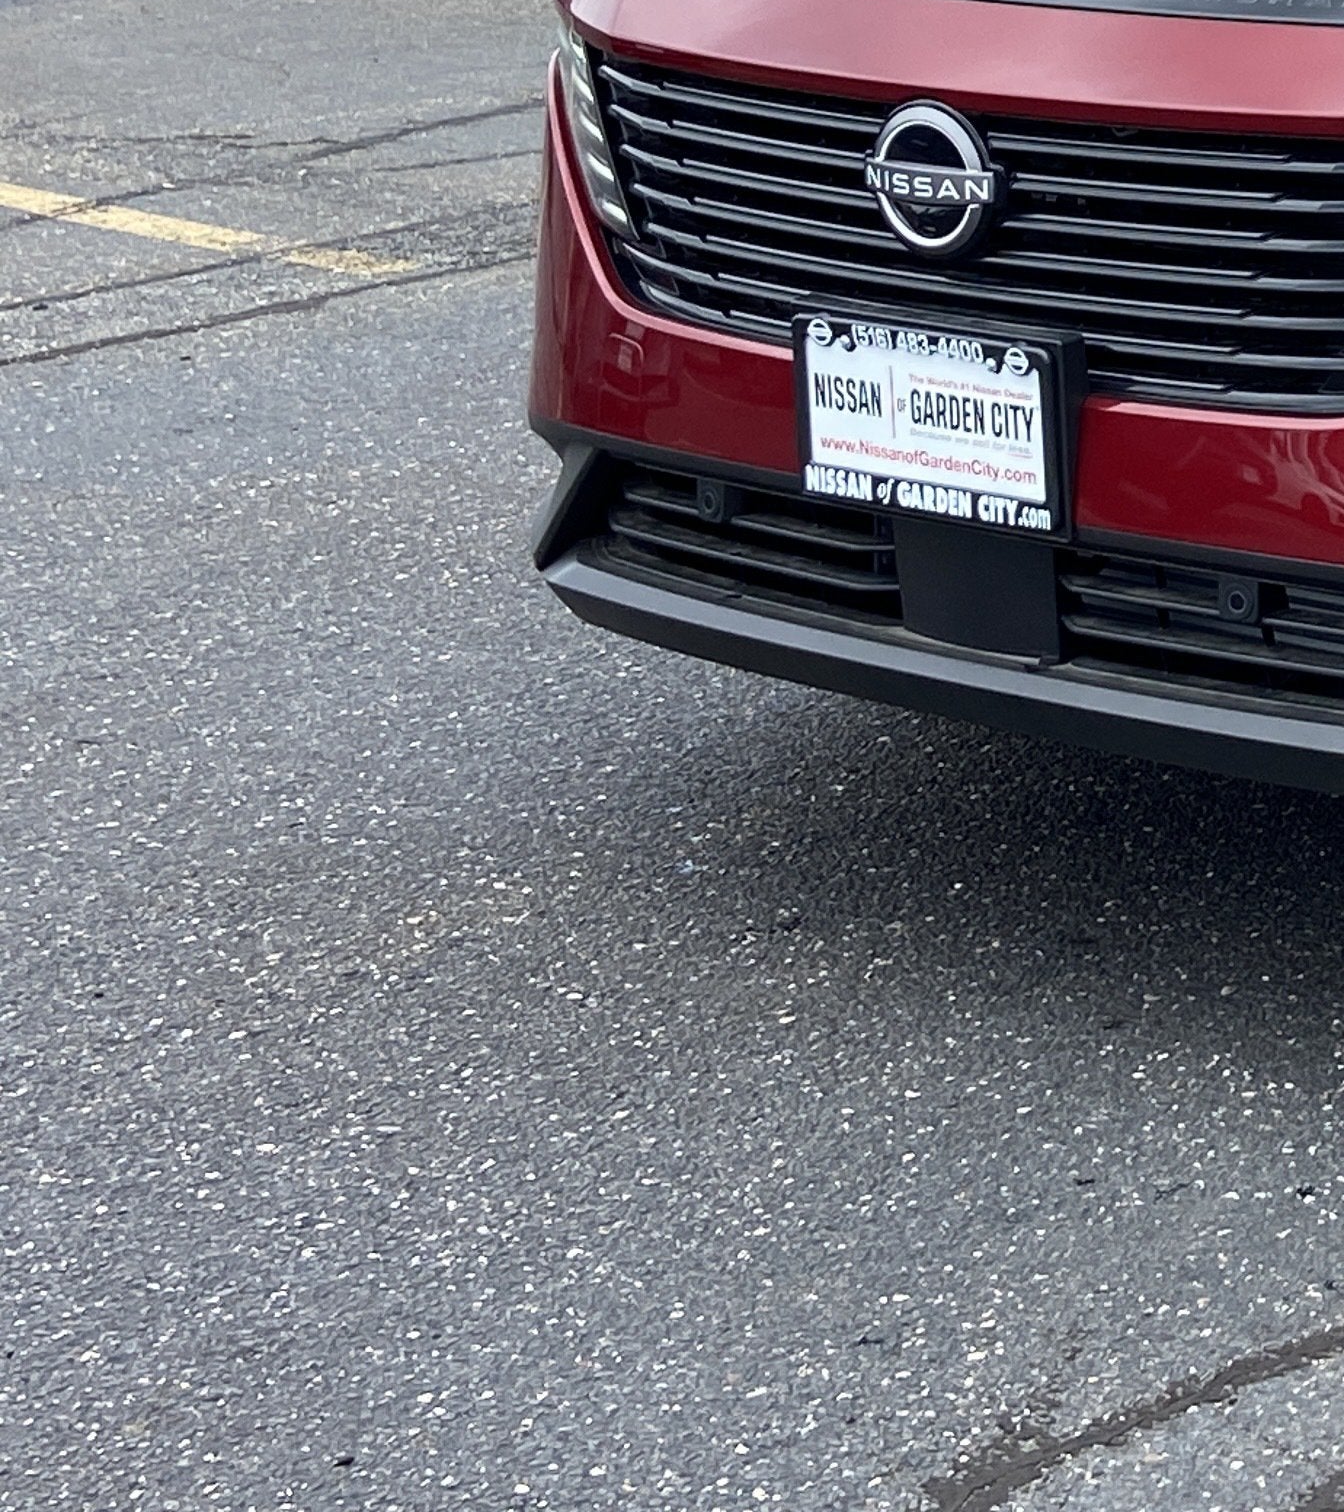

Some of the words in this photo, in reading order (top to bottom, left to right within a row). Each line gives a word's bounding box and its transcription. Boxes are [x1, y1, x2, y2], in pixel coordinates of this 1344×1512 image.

[866, 164, 989, 200] NISSAN
[851, 324, 893, 350] (516)
[896, 331, 984, 365] 483-4400
[814, 372, 882, 418] NISSAN
[896, 397, 907, 413] OF
[910, 388, 985, 436] GARDEN
[991, 402, 1034, 442] CITY
[820, 437, 1037, 484] www.NissanofGardenCity.com
[805, 464, 873, 501] NISSAN
[877, 478, 894, 505] of
[897, 481, 972, 519] GARDEN
[977, 494, 1051, 531] CITY.com
